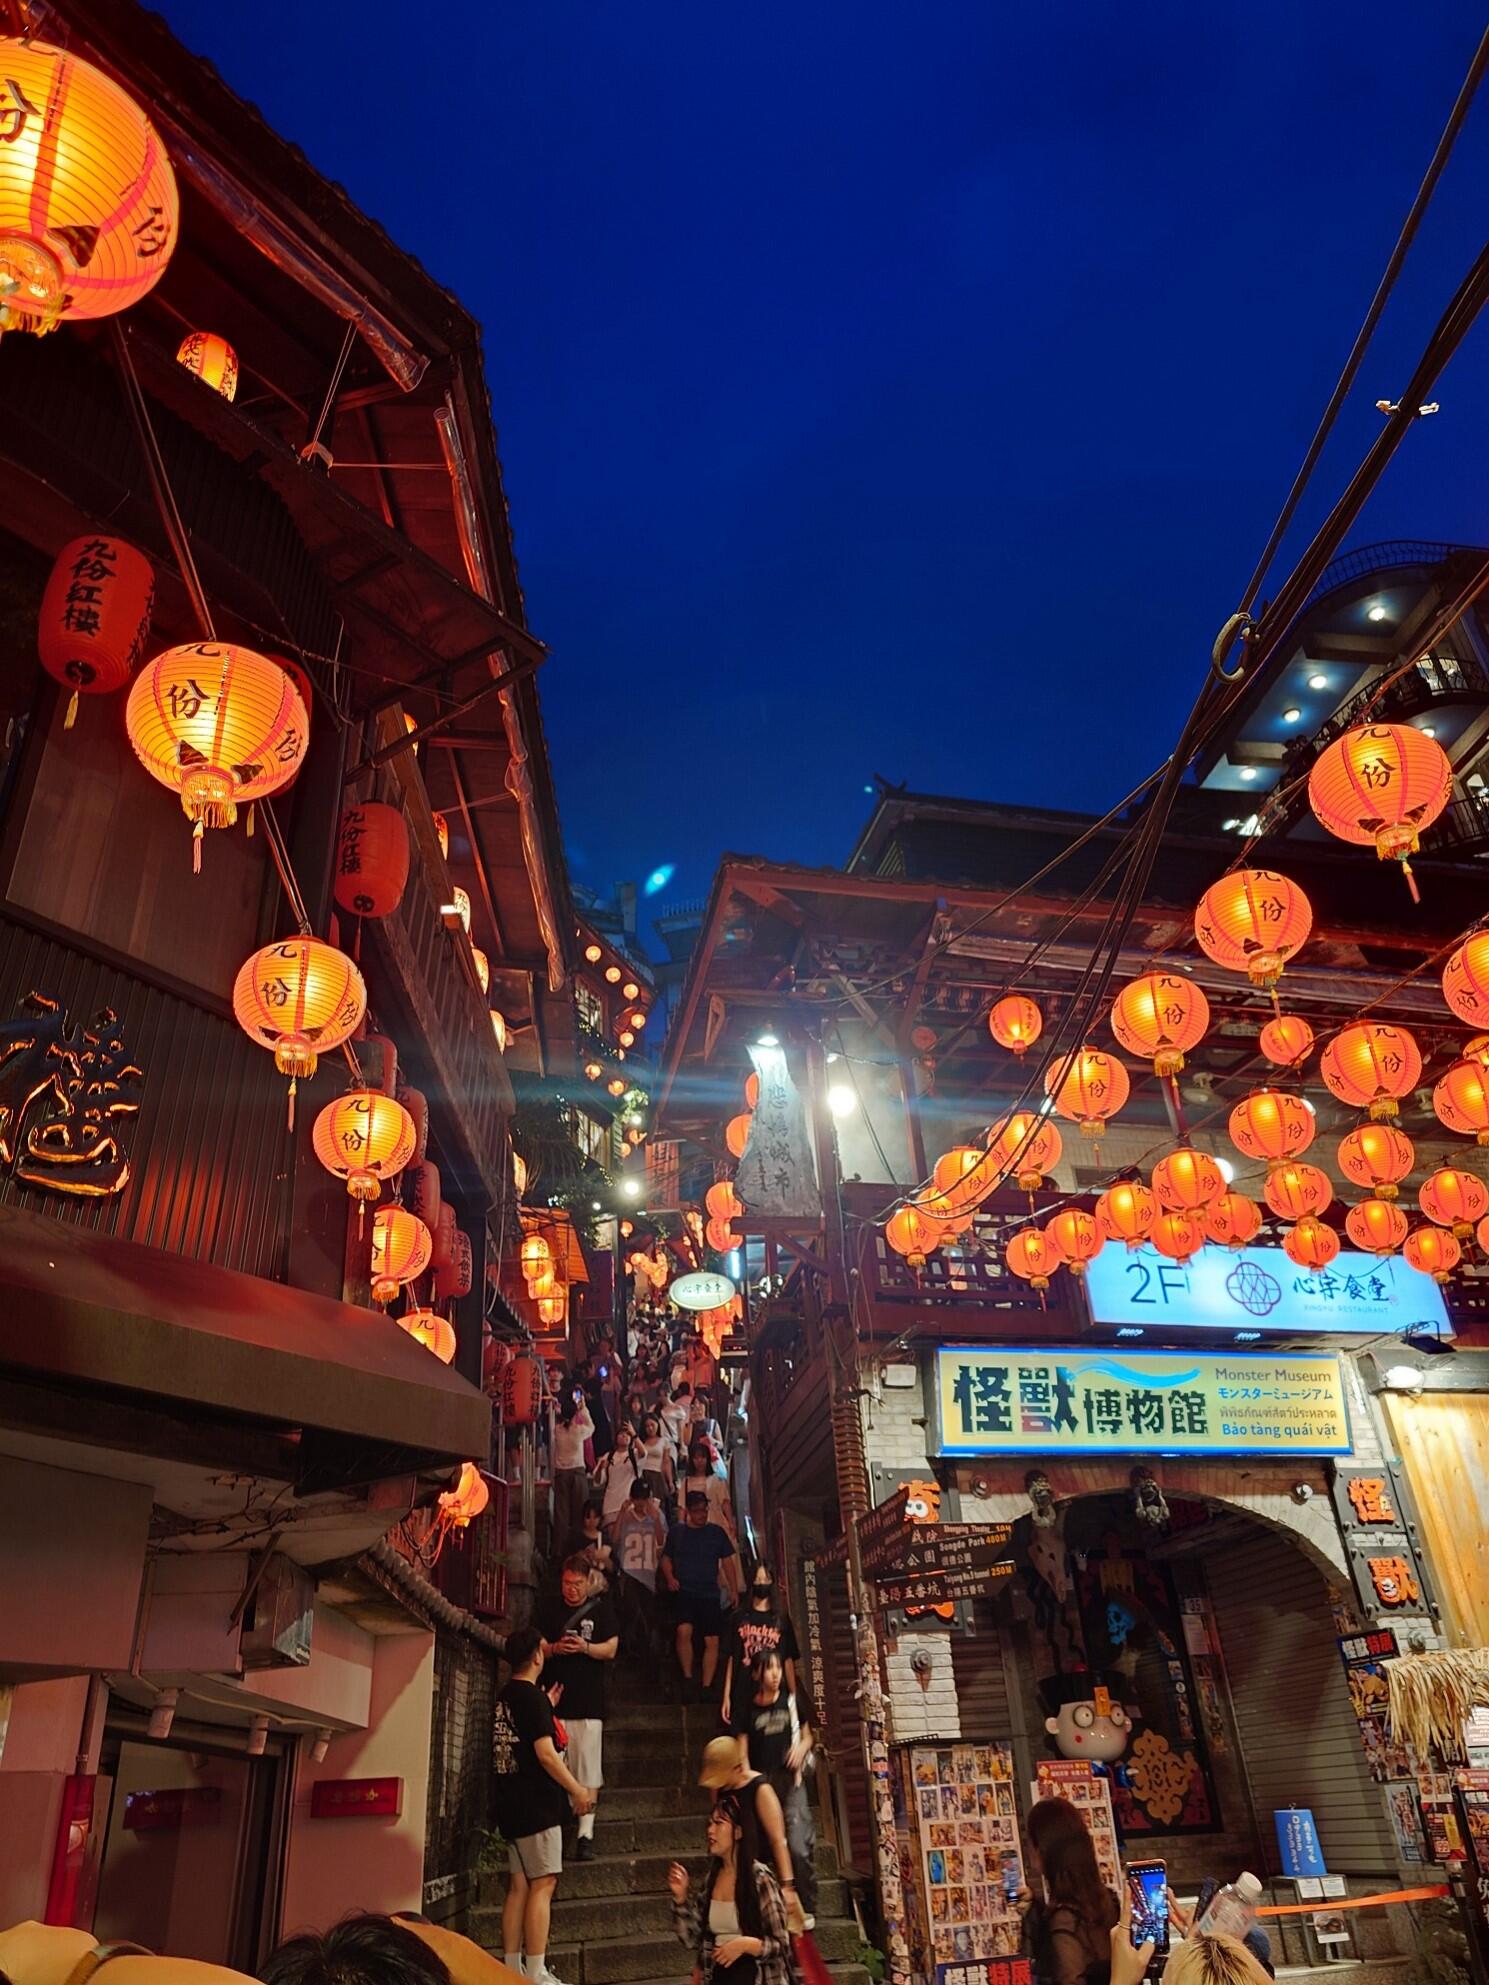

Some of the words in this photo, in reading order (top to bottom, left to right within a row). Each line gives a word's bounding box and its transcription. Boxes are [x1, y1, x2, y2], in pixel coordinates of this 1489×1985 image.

[60, 540, 117, 637] 九份紅樓
[167, 644, 221, 719] 九份
[1356, 728, 1396, 789] 九份
[1255, 872, 1286, 921] 九份
[262, 944, 297, 1007] 九份
[1160, 978, 1186, 1025] 九份
[1376, 1028, 1403, 1072] 九份
[1088, 1056, 1107, 1098] 九份
[341, 1100, 370, 1151] 九份
[1284, 1098, 1304, 1139] 九份
[1464, 1175, 1481, 1208] 九份
[1126, 1263, 1185, 1304] 2F
[1215, 1368, 1271, 1381] Monster
[1274, 1369, 1332, 1382] Museum
[1218, 1387, 1333, 1400] モンスターミュージアム
[953, 1365, 1209, 1434] 怪獸博物館
[1251, 1421, 1281, 1438] tàng
[1284, 1423, 1313, 1439] quái
[1316, 1422, 1337, 1439] vật
[624, 1533, 656, 1570] 21
[968, 1536, 985, 1548] Park
[991, 1565, 1013, 1577] 250M
